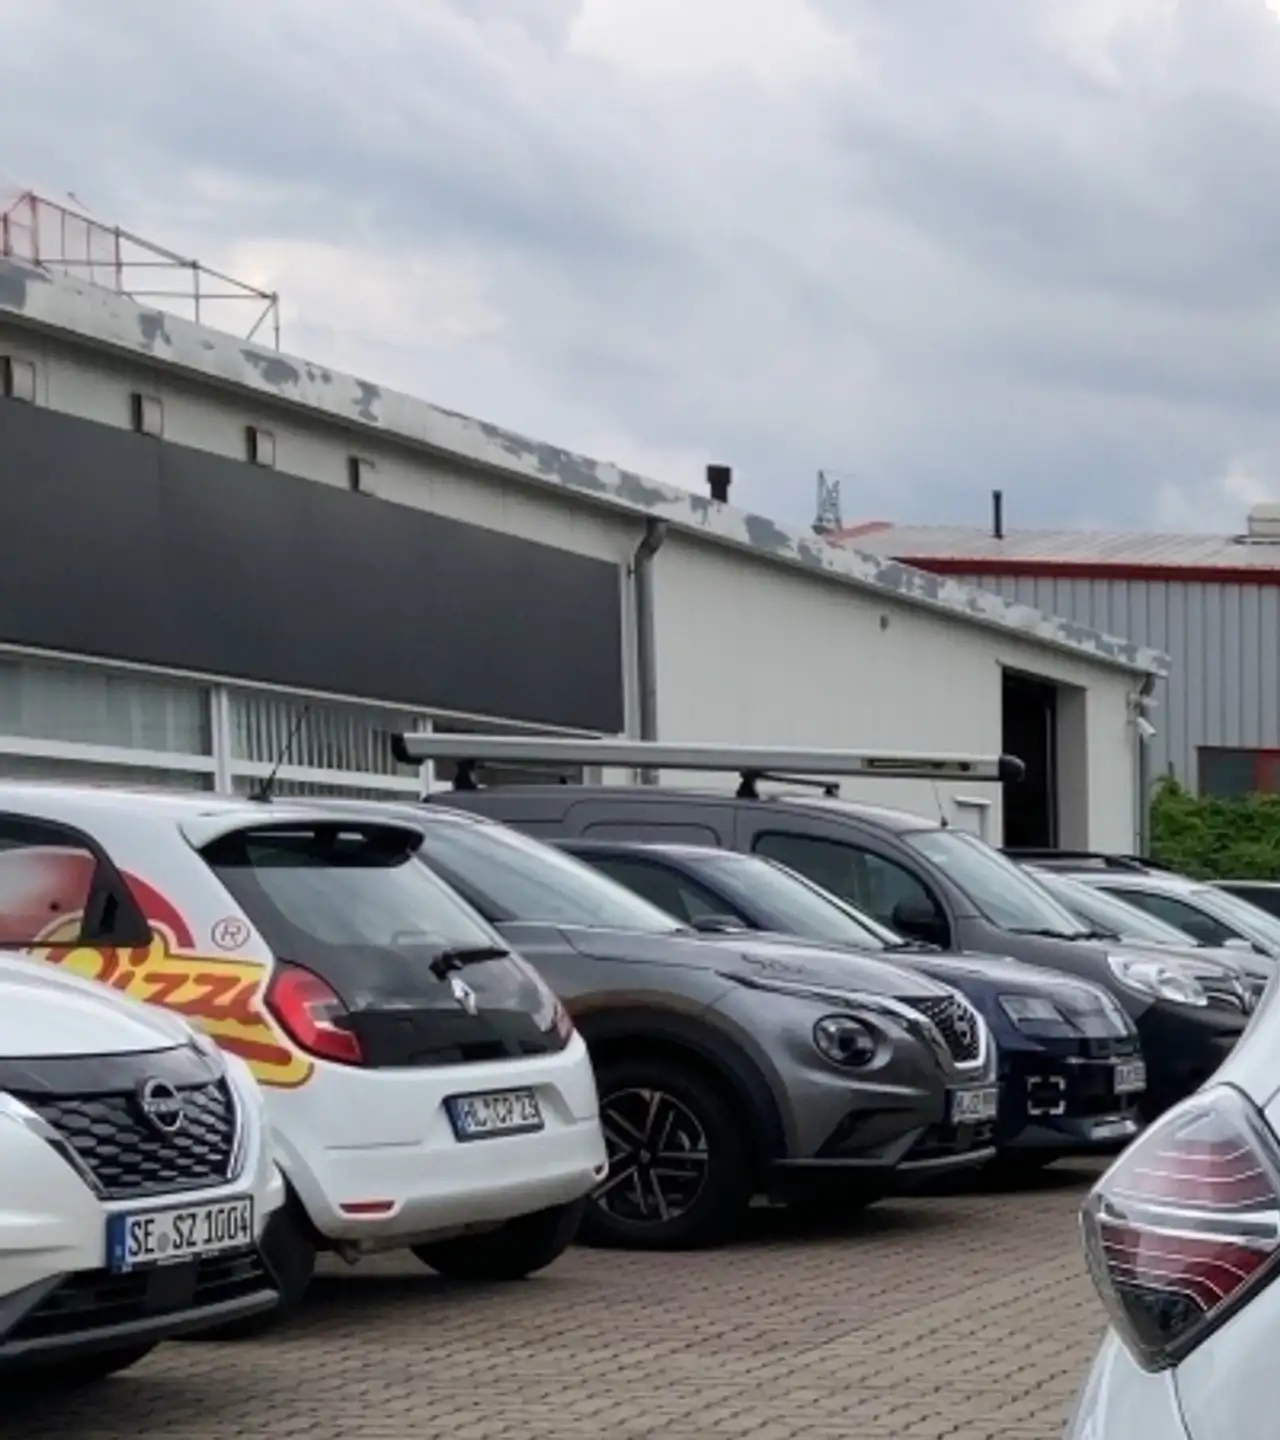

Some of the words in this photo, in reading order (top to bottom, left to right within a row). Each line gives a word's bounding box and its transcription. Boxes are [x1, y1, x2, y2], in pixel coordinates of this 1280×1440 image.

[128, 1219, 155, 1256] SE
[172, 1213, 197, 1250] SZ
[203, 1204, 250, 1245] 1004
